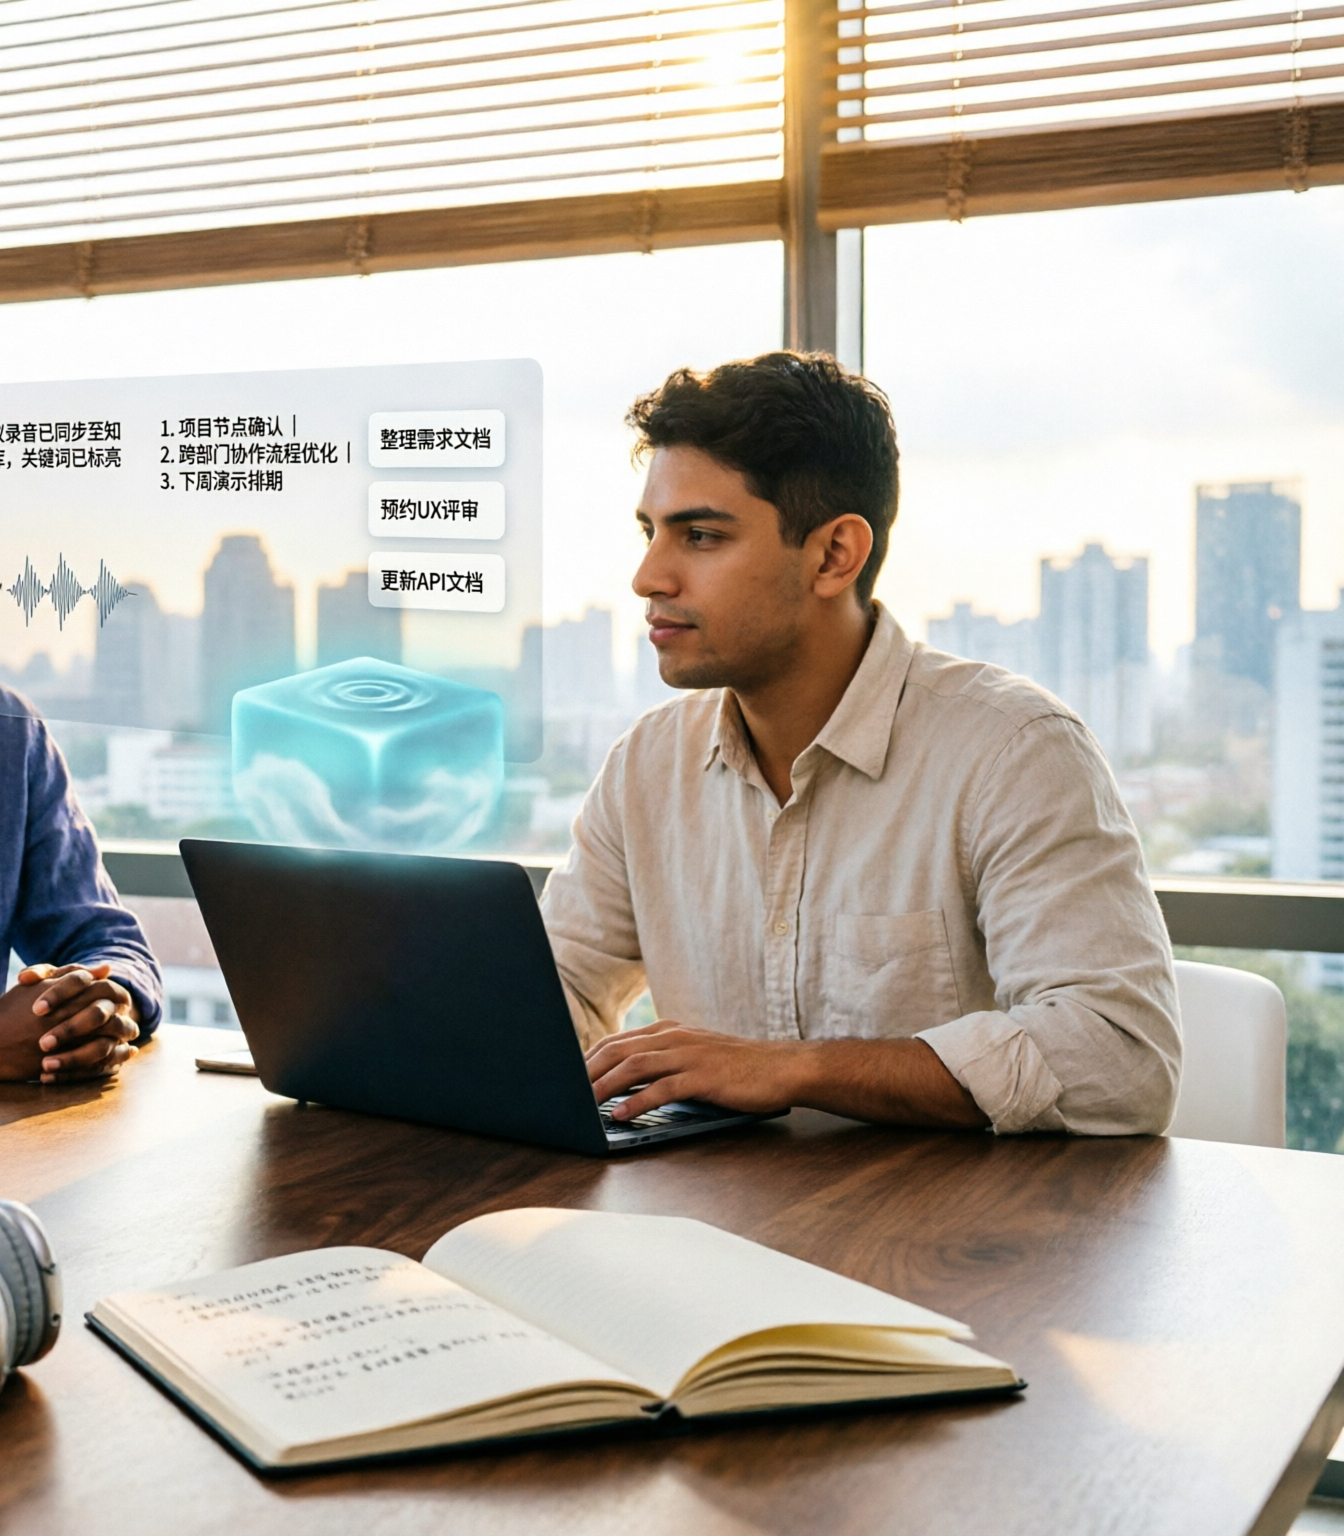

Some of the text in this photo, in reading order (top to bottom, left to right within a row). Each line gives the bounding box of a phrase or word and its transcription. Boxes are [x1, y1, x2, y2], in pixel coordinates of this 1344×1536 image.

[178, 415, 283, 438] 项目节点确认
[380, 427, 491, 450] 整理需求文档
[178, 441, 338, 465] 跨部门协作流程优化
[178, 469, 283, 492] 下周演示排期
[380, 498, 479, 522] 预约UX评审
[380, 569, 483, 594] 更新API文档
